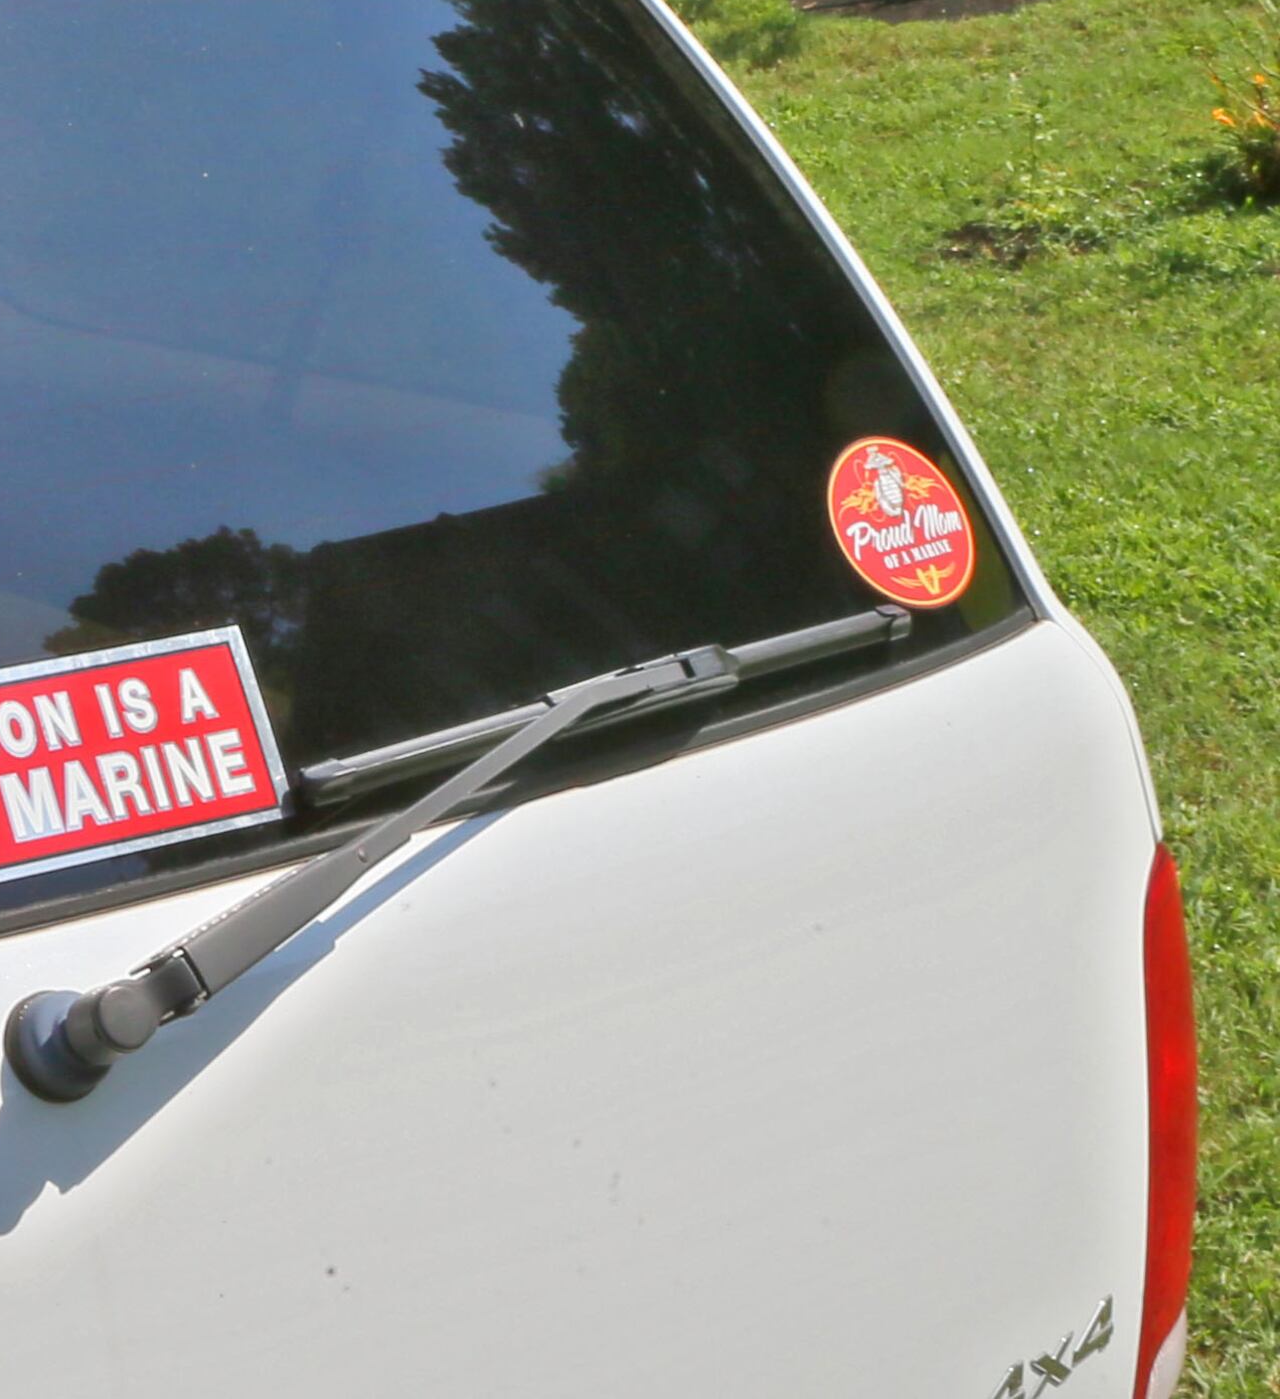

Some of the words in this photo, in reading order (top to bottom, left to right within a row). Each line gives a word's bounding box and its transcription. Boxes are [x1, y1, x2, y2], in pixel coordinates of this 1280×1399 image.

[846, 510, 914, 561] Proud
[914, 504, 962, 540] Mom
[884, 556, 900, 569] OF
[901, 551, 912, 564] A
[911, 540, 952, 561] MARINE
[94, 677, 158, 737] IS
[180, 668, 220, 723] A
